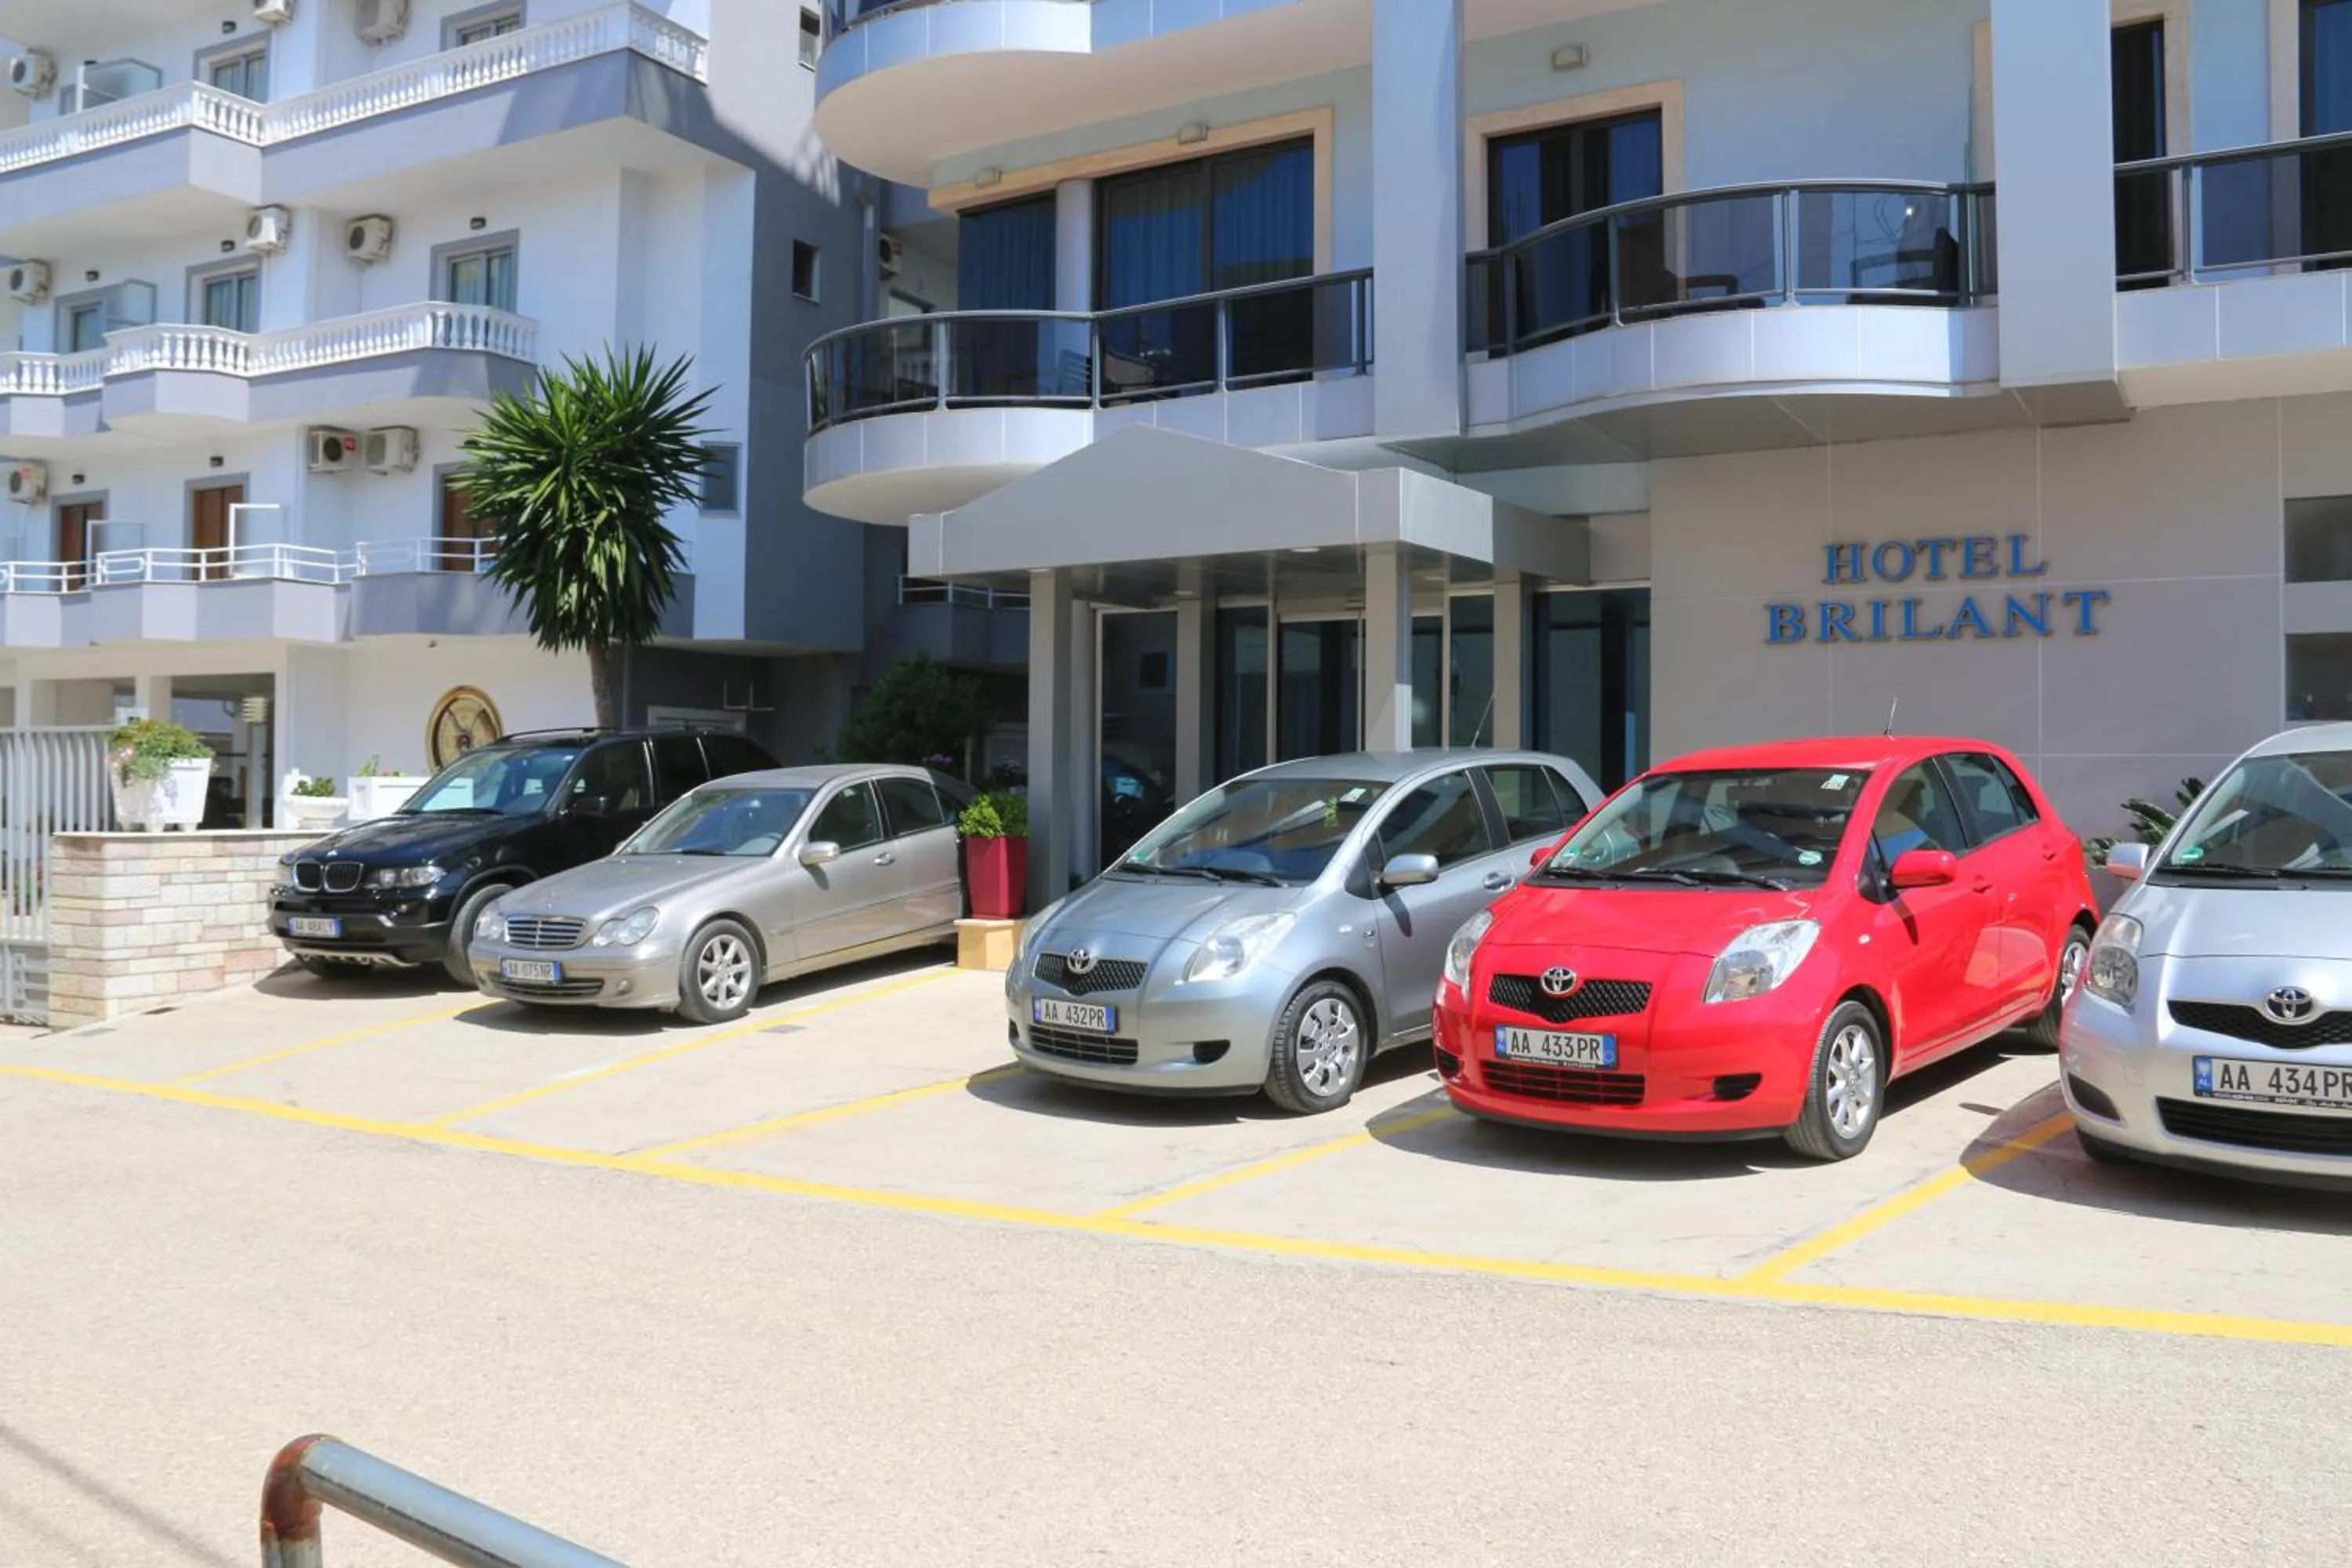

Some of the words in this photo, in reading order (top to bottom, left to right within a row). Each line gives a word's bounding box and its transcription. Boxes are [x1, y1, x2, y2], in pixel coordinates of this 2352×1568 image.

[1821, 532, 2049, 584] HOTEL
[1762, 590, 2112, 646] BRILANT
[1045, 1001, 1058, 1021] AA
[1065, 1005, 1105, 1027] 432PR
[1511, 1031, 1531, 1054] AA
[1541, 1034, 1600, 1061] 433PR
[2220, 1063, 2251, 1091] AA
[2268, 1067, 2352, 1098] 434PR
